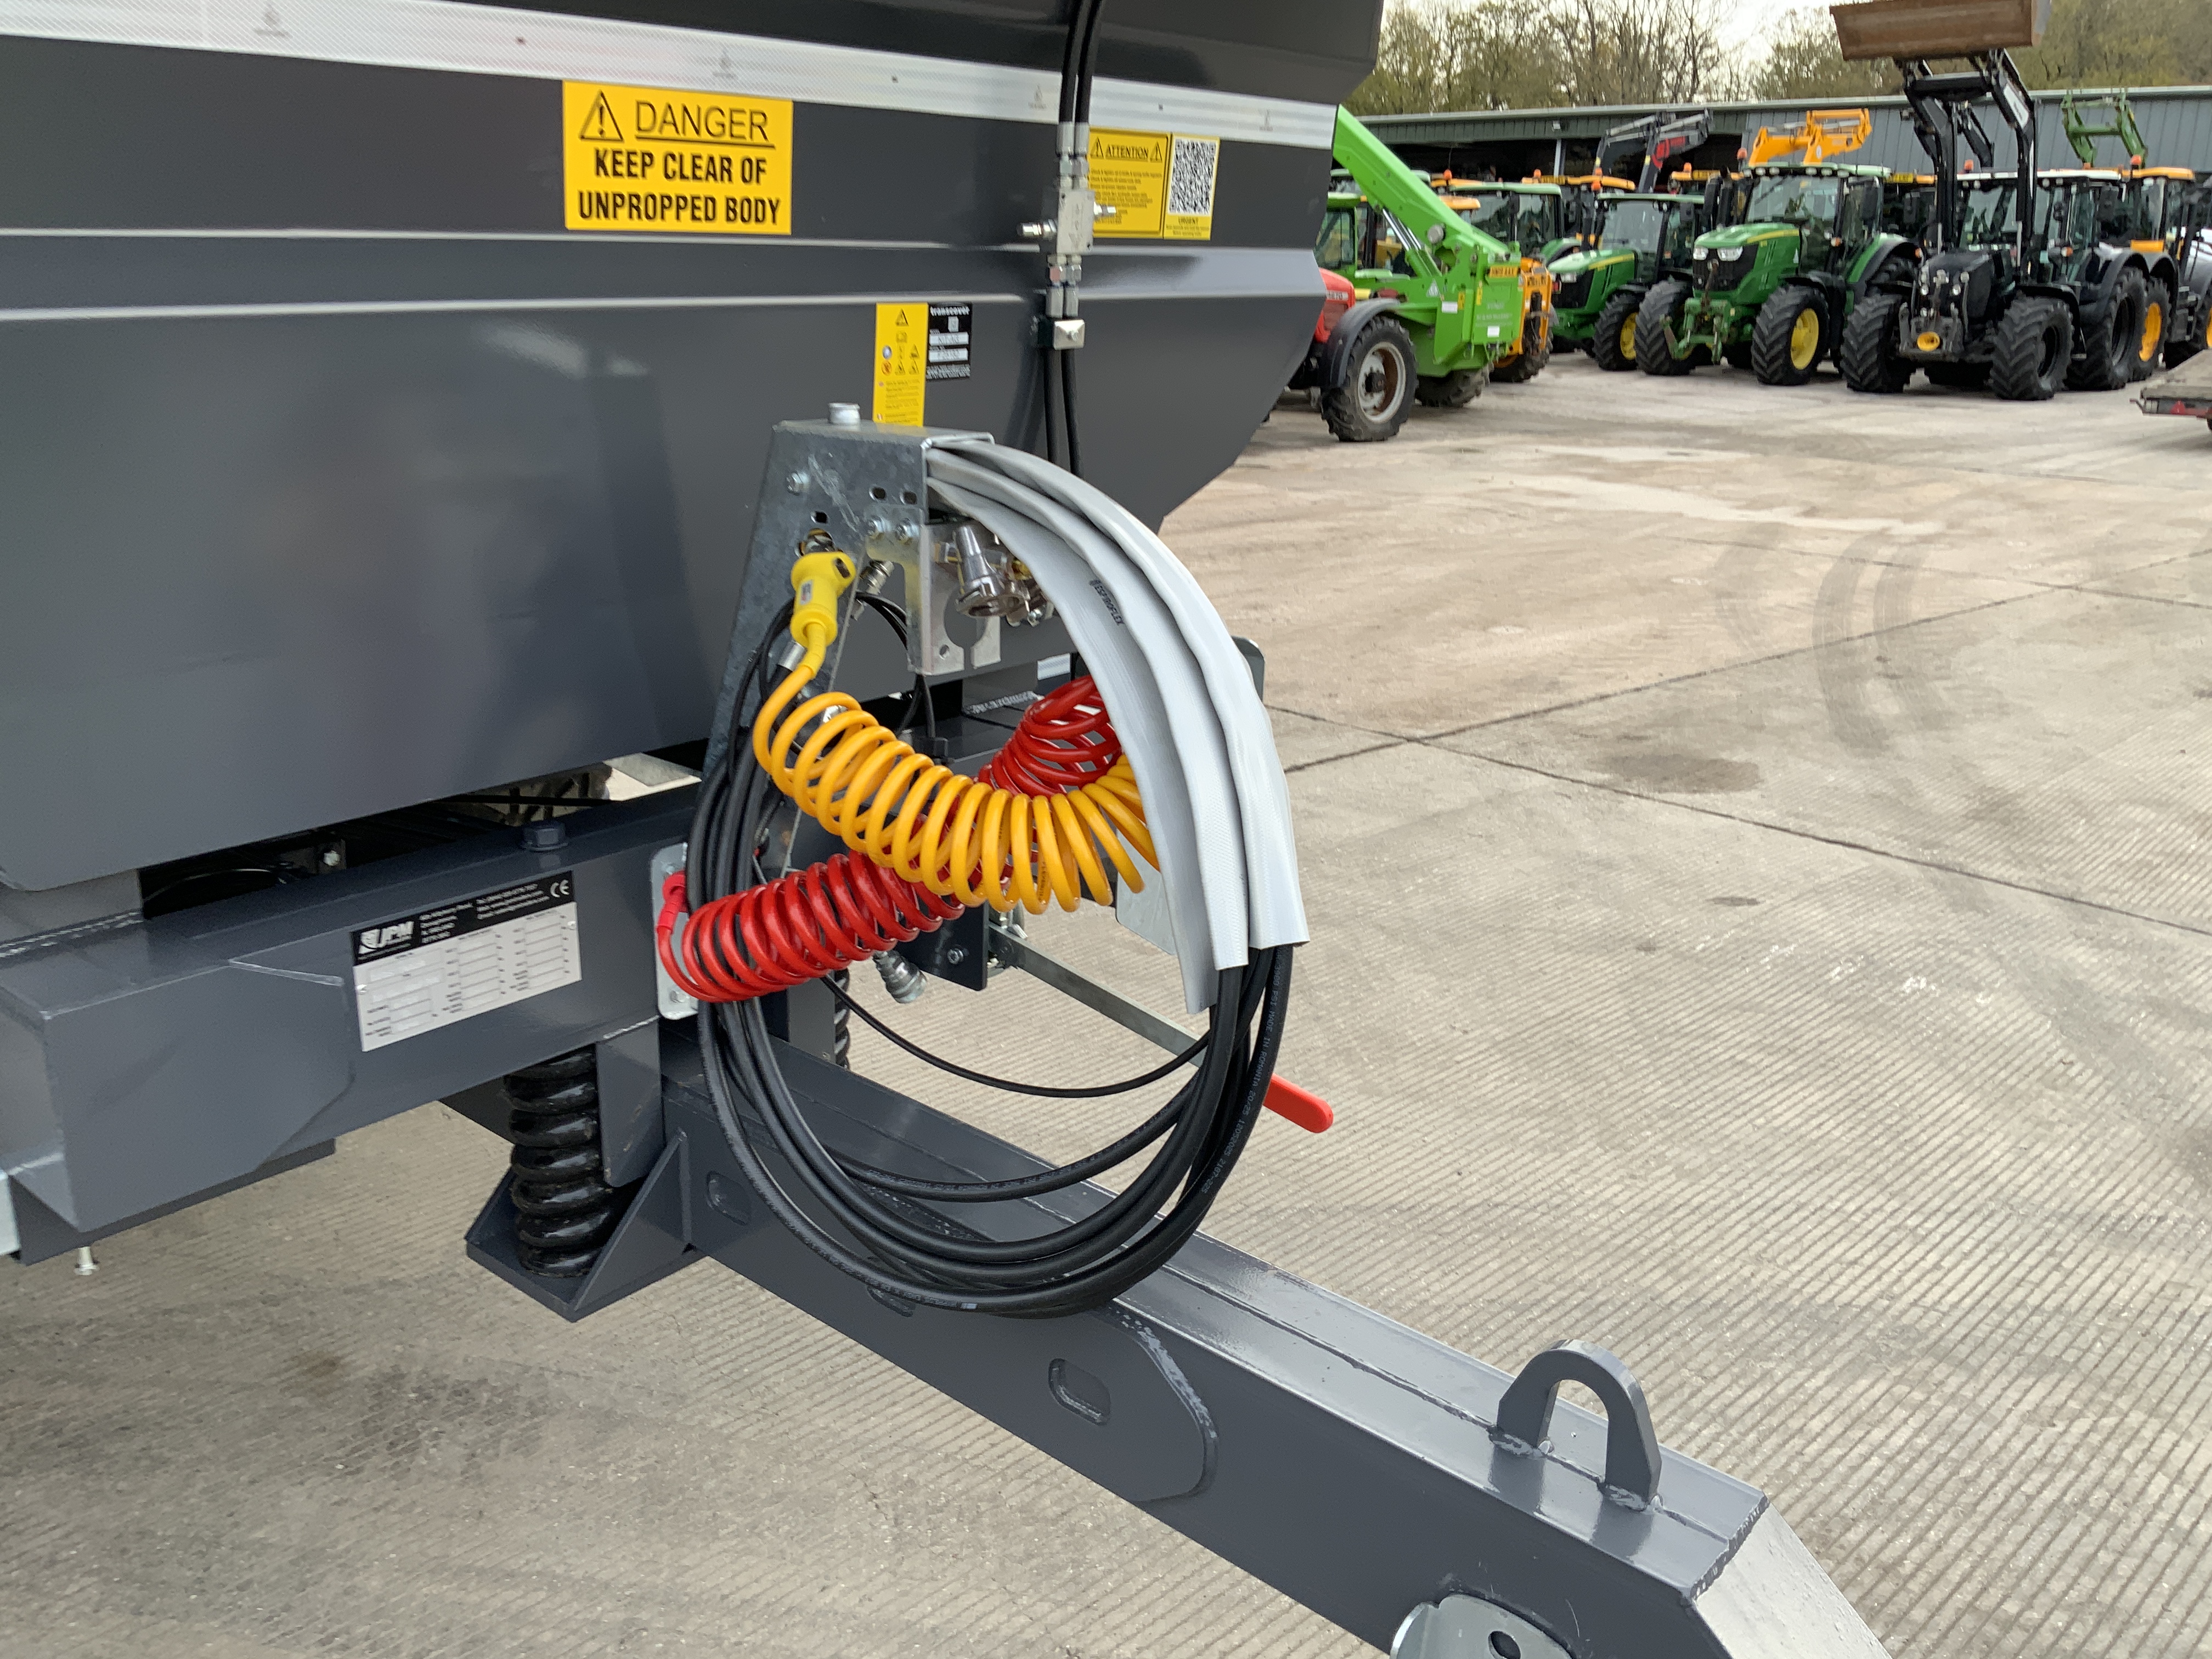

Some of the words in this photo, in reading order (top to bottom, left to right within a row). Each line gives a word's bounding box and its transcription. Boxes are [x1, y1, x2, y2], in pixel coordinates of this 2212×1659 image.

[636, 100, 769, 142] DANGER
[1105, 144, 1149, 160] ATTENTION
[595, 148, 654, 180] KEEP
[664, 153, 733, 184] CLEAR
[741, 157, 768, 185] OF
[578, 190, 716, 222] UNPROPPED
[726, 196, 781, 225] BODY
[1270, 990, 1279, 1006] PSI
[1266, 1011, 1276, 1032] MADE
[1263, 1036, 1271, 1048] IN
[1252, 1051, 1267, 1087] ROMANIA
